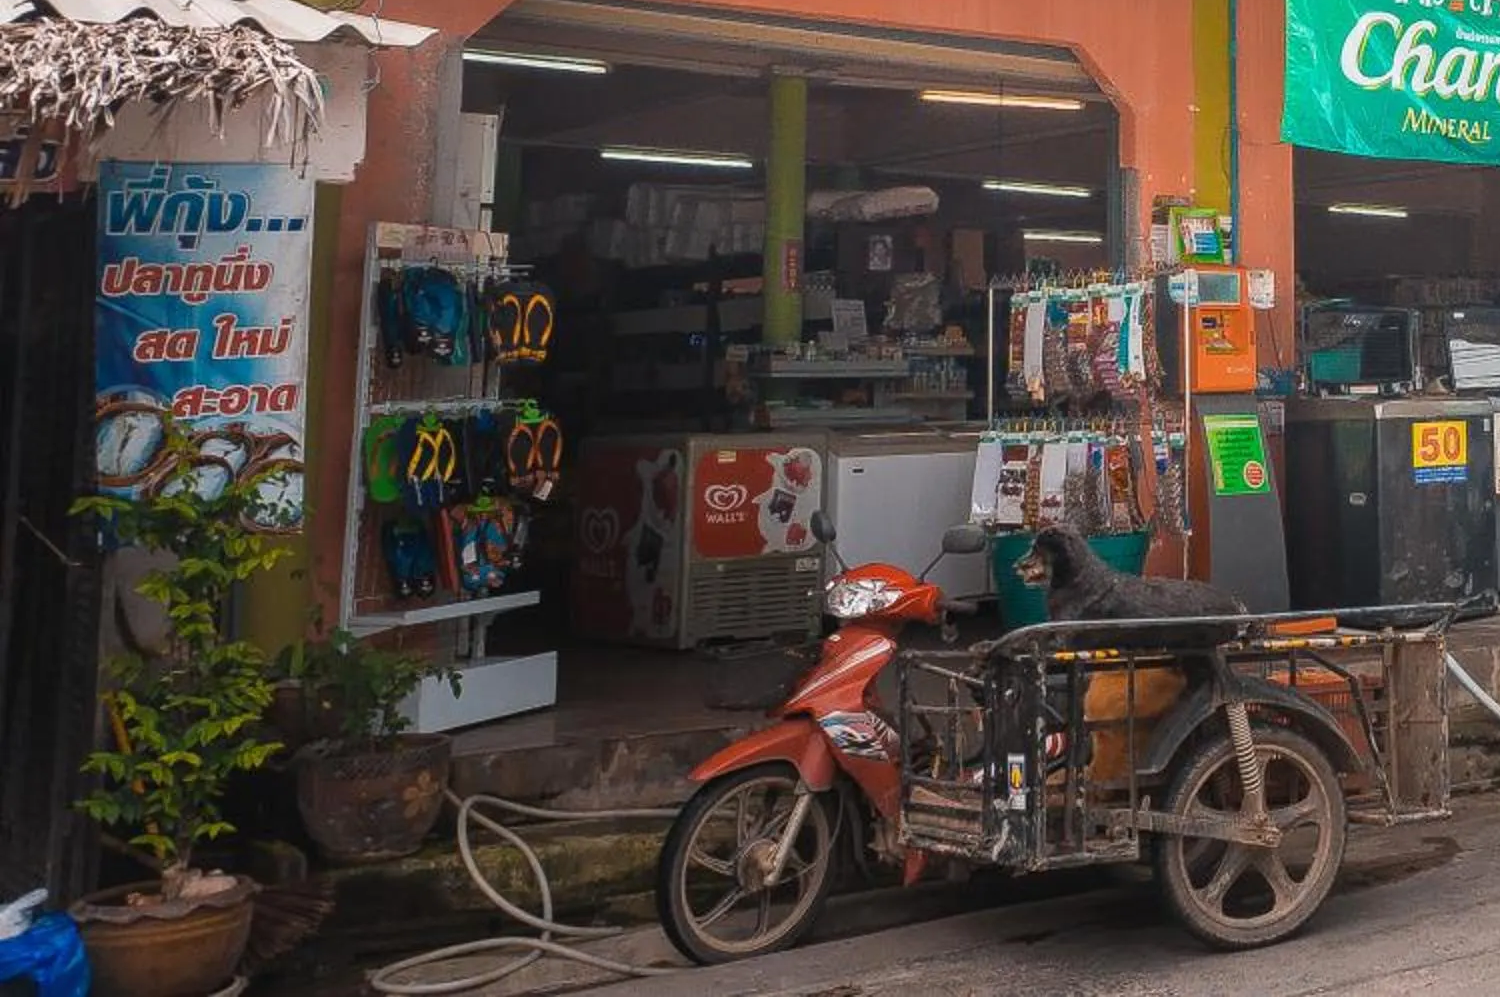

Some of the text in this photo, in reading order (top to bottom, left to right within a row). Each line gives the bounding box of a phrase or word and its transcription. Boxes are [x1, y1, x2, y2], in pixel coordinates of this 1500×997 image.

[134, 313, 296, 361] สด ใหม่
[172, 383, 299, 418] สะอาด
[1420, 426, 1461, 462] 50
